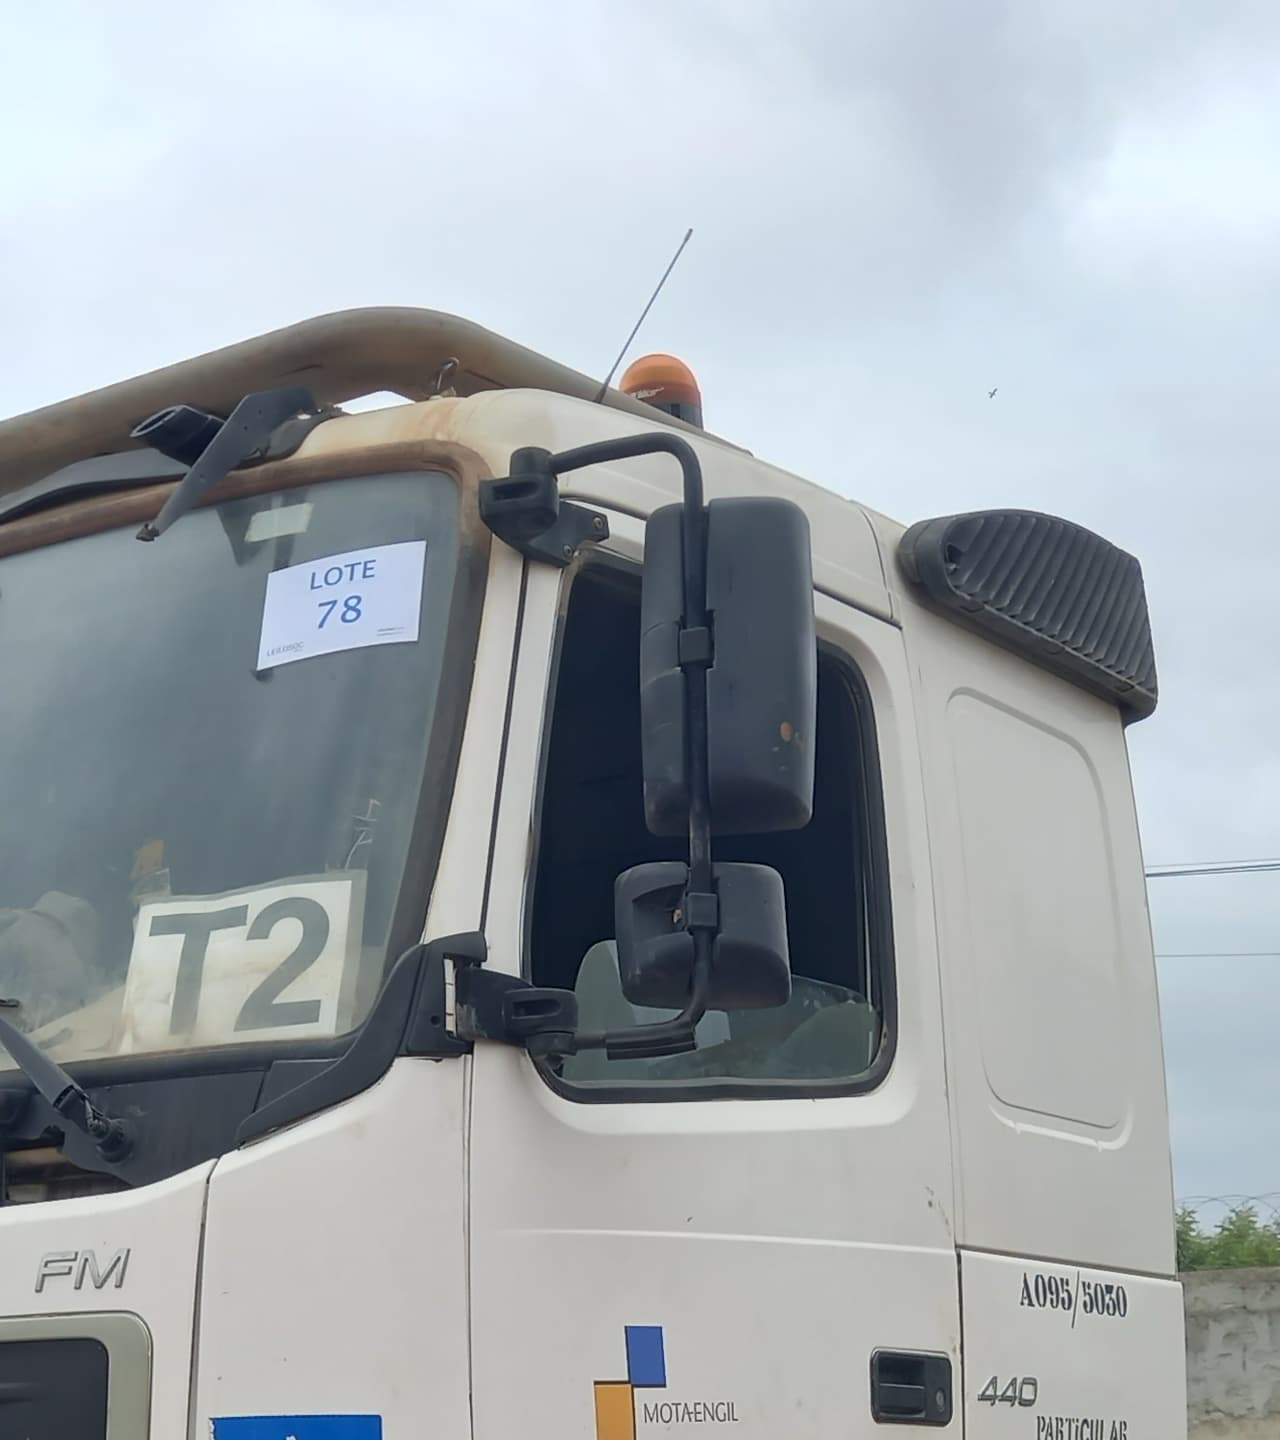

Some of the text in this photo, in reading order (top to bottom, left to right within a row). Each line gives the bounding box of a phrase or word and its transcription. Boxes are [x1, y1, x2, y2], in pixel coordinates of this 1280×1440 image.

[309, 559, 377, 591] LOTE
[317, 594, 363, 630] 78
[148, 896, 330, 1035] T2
[34, 1247, 132, 1294] FM
[976, 1375, 1039, 1408] 440
